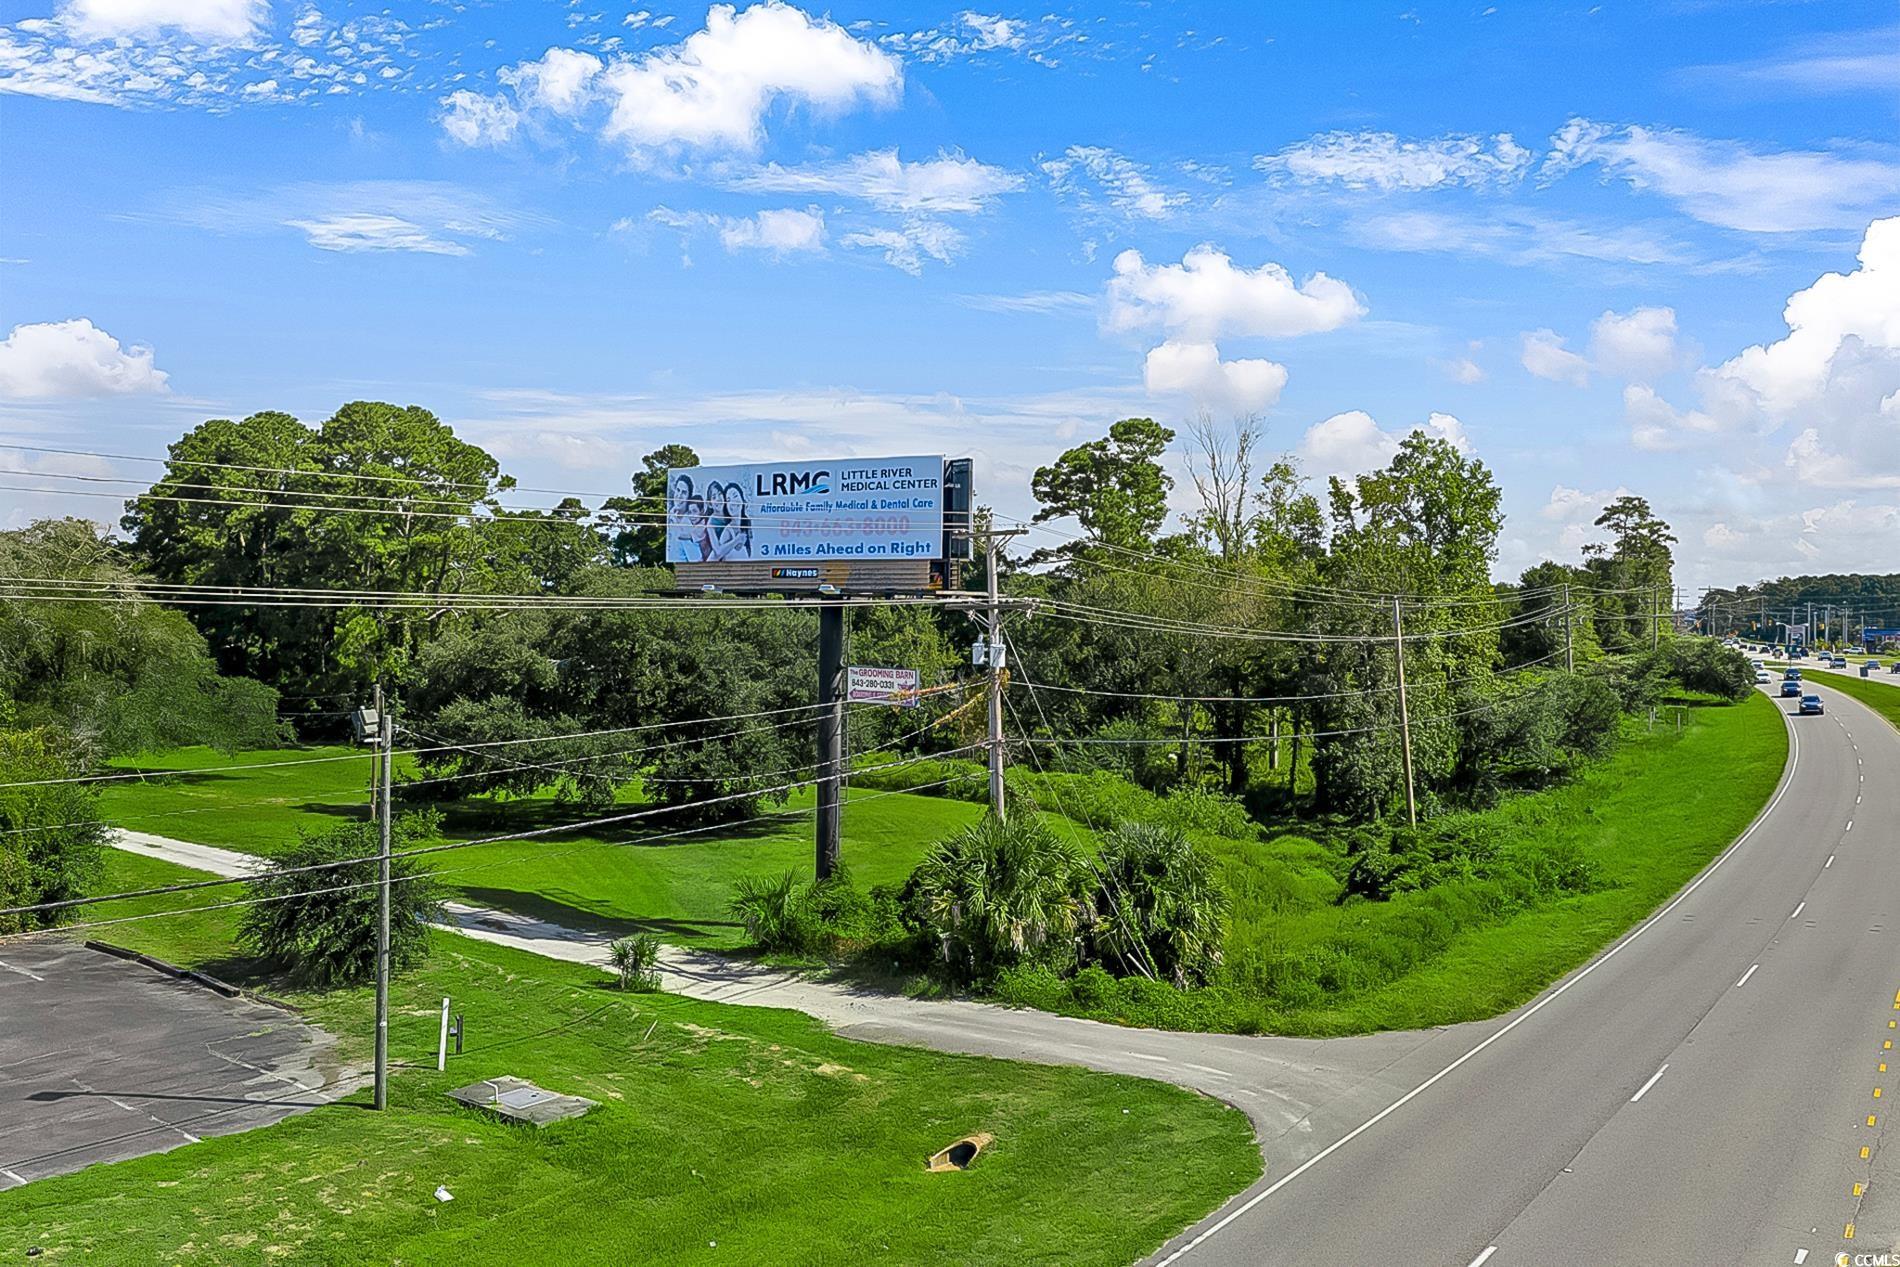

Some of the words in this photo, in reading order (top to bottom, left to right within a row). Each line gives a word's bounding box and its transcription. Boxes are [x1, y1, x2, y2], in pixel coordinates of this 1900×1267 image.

[841, 469, 878, 480] LITTLE
[881, 468, 912, 478] RIVER
[757, 470, 830, 496] LRMC
[841, 480, 890, 491] MEDICAL
[893, 478, 938, 490] CENTER
[760, 502, 804, 513] Affordable
[806, 501, 833, 513] Family
[835, 499, 869, 510] Medical
[872, 499, 878, 509] &
[880, 498, 910, 509] Dental
[913, 497, 934, 509] Care
[761, 544, 770, 556] 3
[774, 543, 811, 555] Miles
[816, 542, 864, 555] Ahead
[867, 543, 886, 554] on
[890, 541, 932, 556] Right
[786, 568, 818, 578] Haynes
[859, 669, 894, 679] GROOMING
[895, 670, 914, 679] BARN
